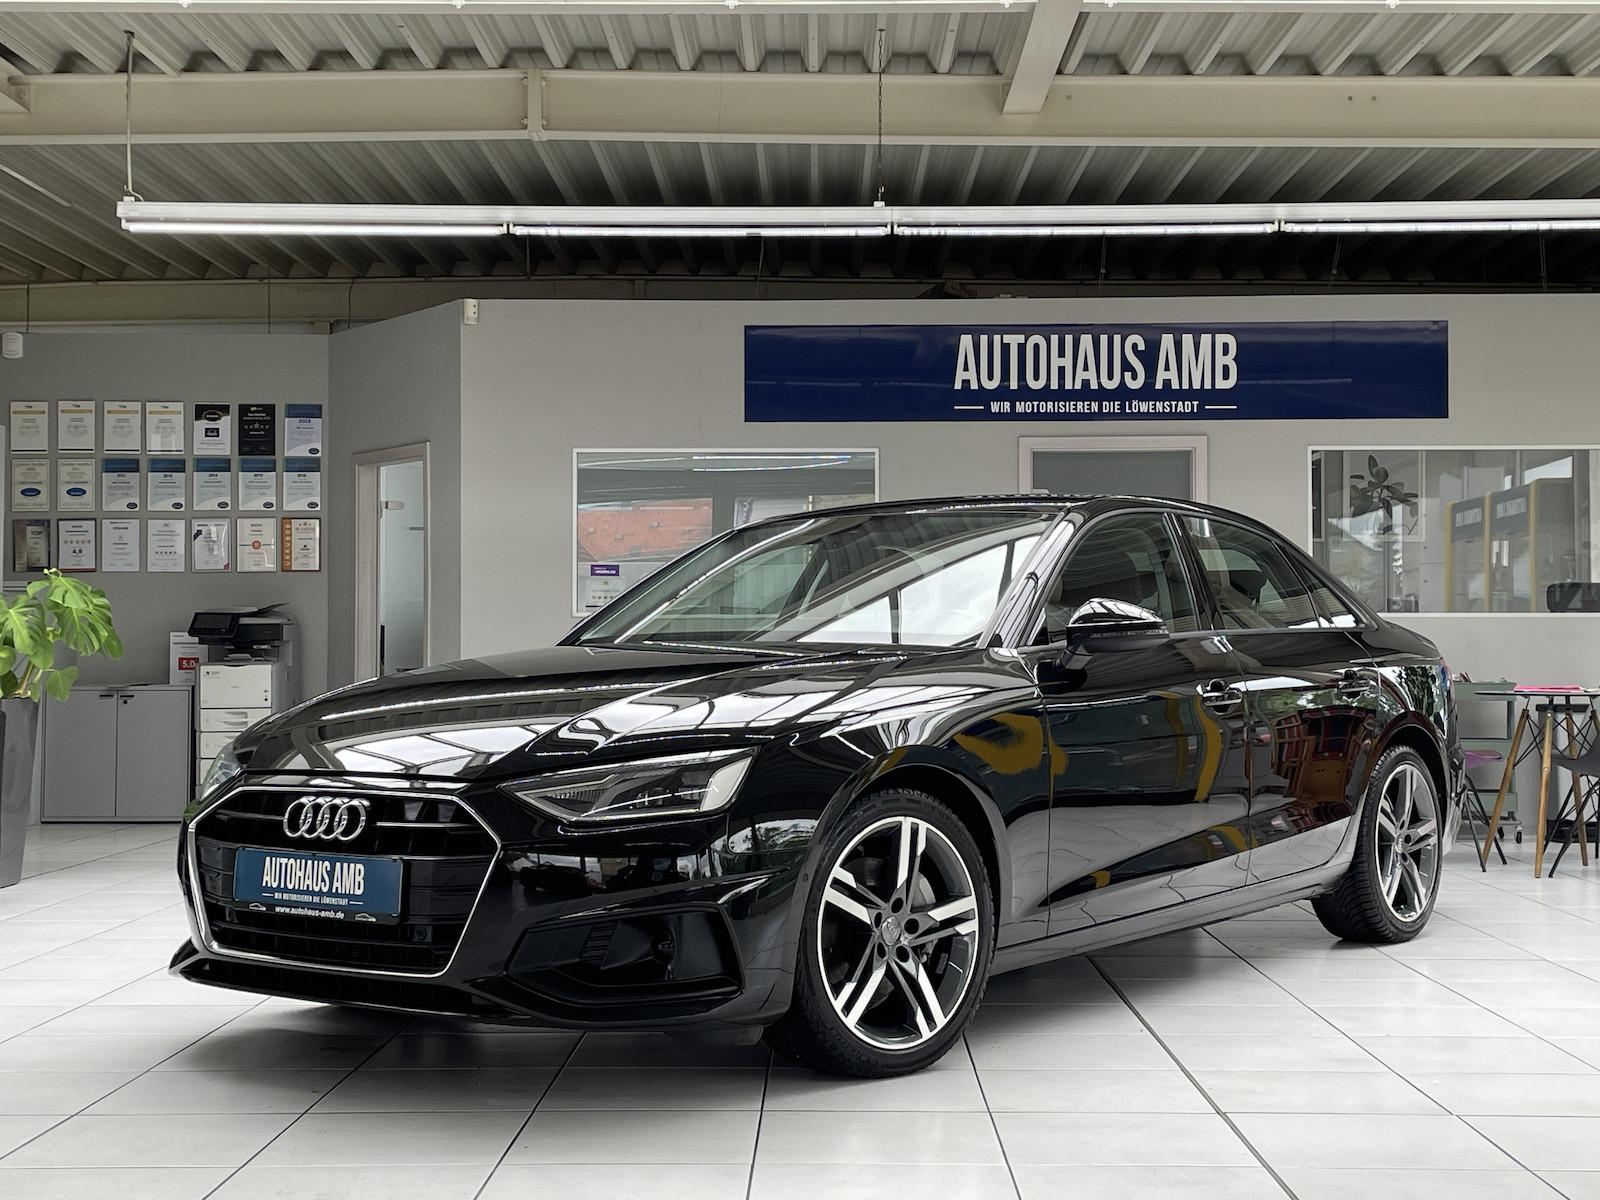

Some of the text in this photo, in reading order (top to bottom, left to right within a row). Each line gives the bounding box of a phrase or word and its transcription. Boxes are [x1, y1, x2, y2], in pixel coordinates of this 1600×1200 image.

[953, 333, 1239, 390] AUTOHAUS AMB
[990, 399, 1200, 413] WIR MOTORISIEREN DIE LÖWENSTADT
[262, 856, 365, 895] AUTOHAUS AMB
[274, 906, 344, 919] www.autohaus-amb.de
